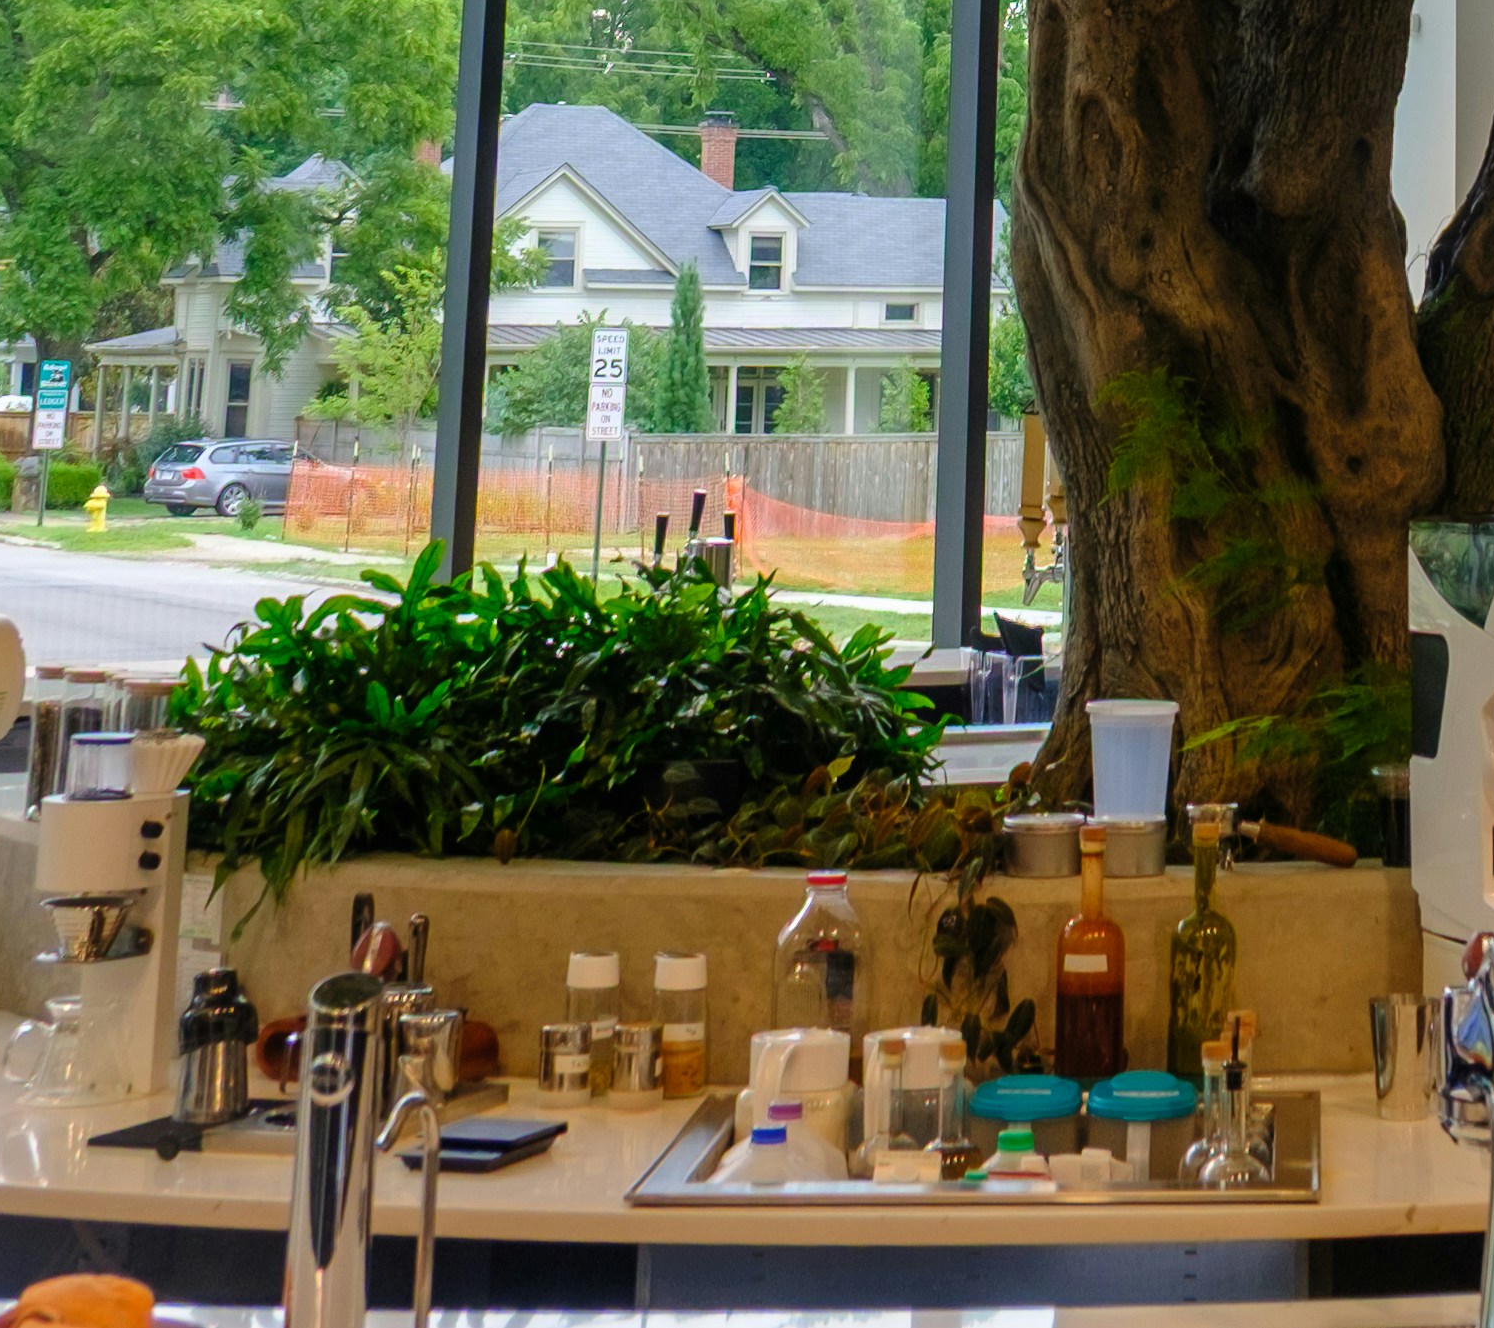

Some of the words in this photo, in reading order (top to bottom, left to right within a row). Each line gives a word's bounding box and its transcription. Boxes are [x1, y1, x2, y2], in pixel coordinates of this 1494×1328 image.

[596, 335, 625, 344] SPEED
[597, 346, 621, 355] LIMIT
[594, 358, 623, 378] 25
[601, 388, 613, 398] NO
[591, 402, 621, 412] PARKING
[600, 415, 611, 423] ON
[592, 426, 618, 436] STREET
